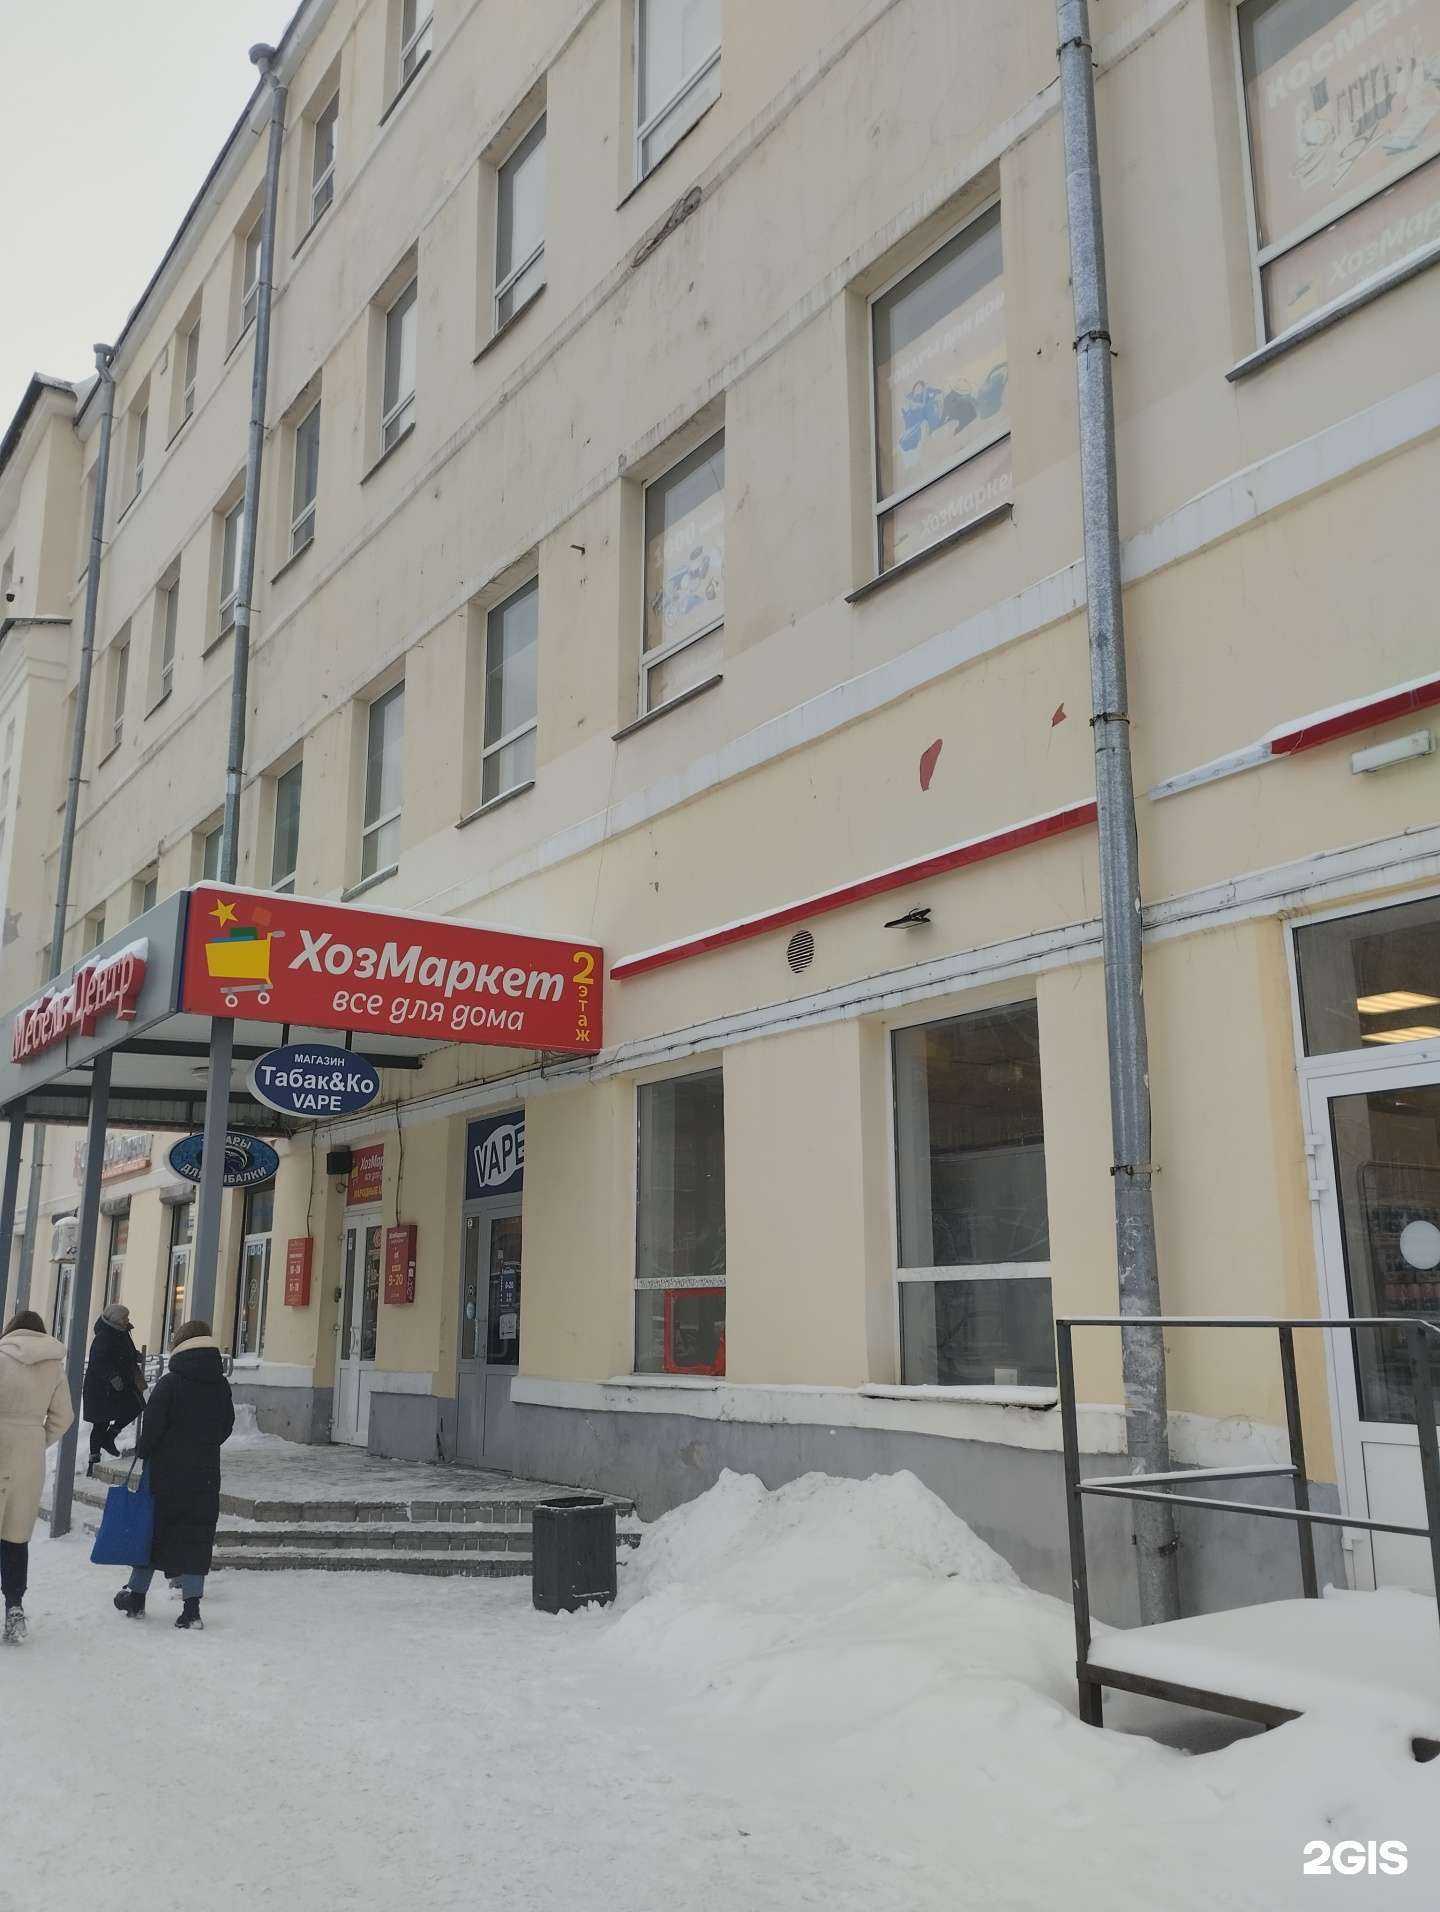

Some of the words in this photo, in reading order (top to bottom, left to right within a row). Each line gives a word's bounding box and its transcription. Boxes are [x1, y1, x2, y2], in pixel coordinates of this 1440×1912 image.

[288, 930, 564, 1001] ХозМаркет
[573, 951, 594, 984] 2
[332, 990, 383, 1015] все
[389, 996, 444, 1024] для
[450, 1003, 524, 1031] дома
[294, 1053, 345, 1067] МАГАЗИН
[261, 1065, 374, 1094] Табак&Ко
[292, 1092, 342, 1111] VAPE
[474, 1125, 525, 1185] VAPE
